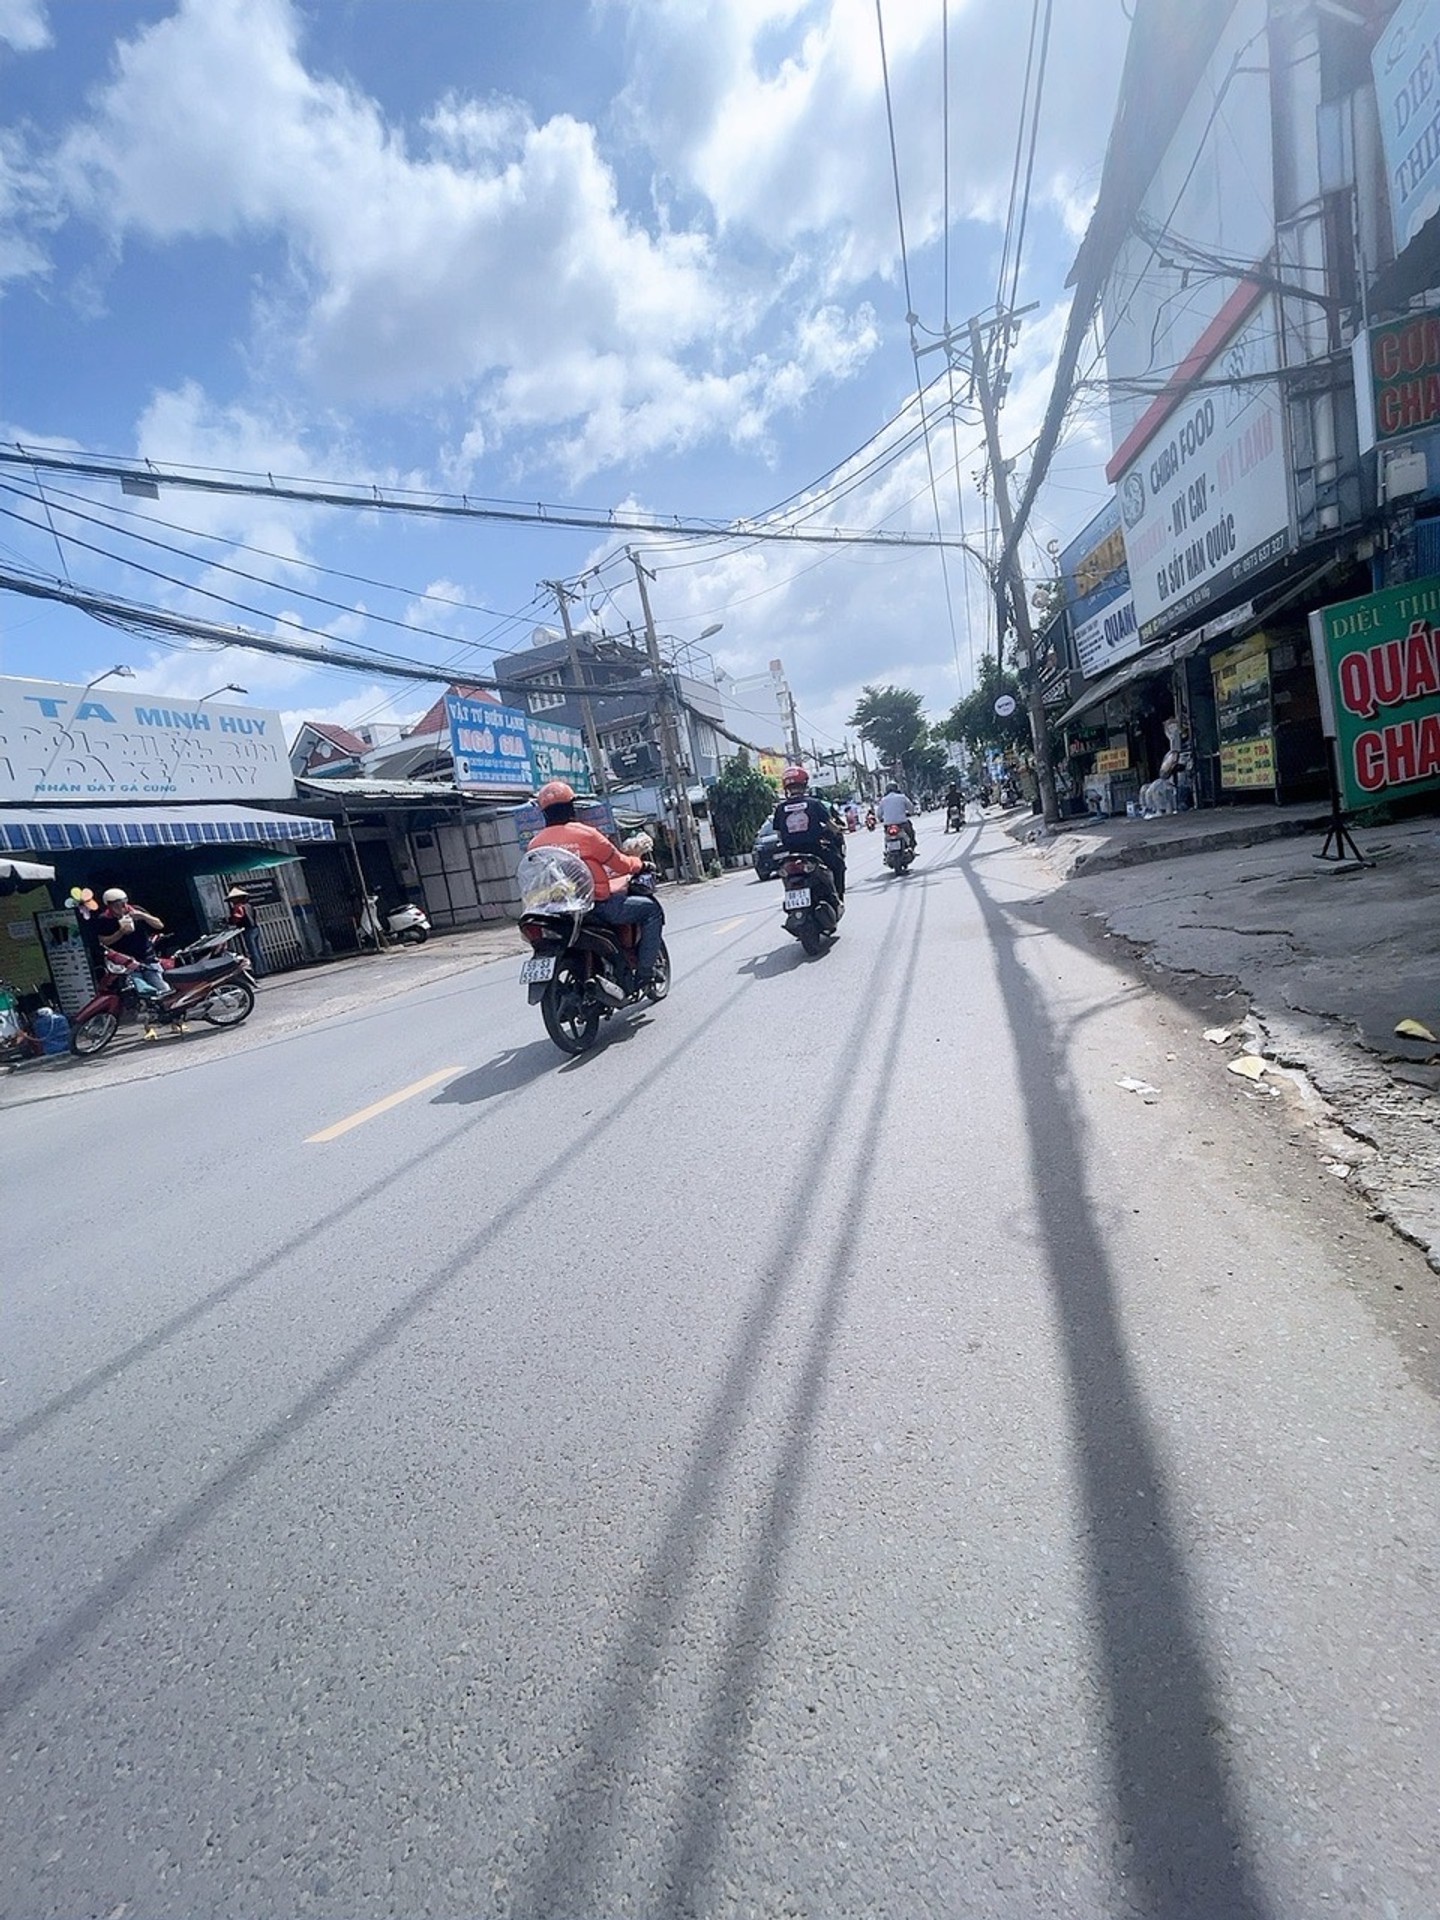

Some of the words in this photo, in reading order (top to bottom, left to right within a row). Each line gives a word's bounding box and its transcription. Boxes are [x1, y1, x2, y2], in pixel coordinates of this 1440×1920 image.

[1150, 440, 1179, 495] CHIBA
[1178, 398, 1215, 466] FOOD
[23, 695, 117, 724] TA
[134, 706, 211, 731] MINH
[218, 715, 266, 736] HUY
